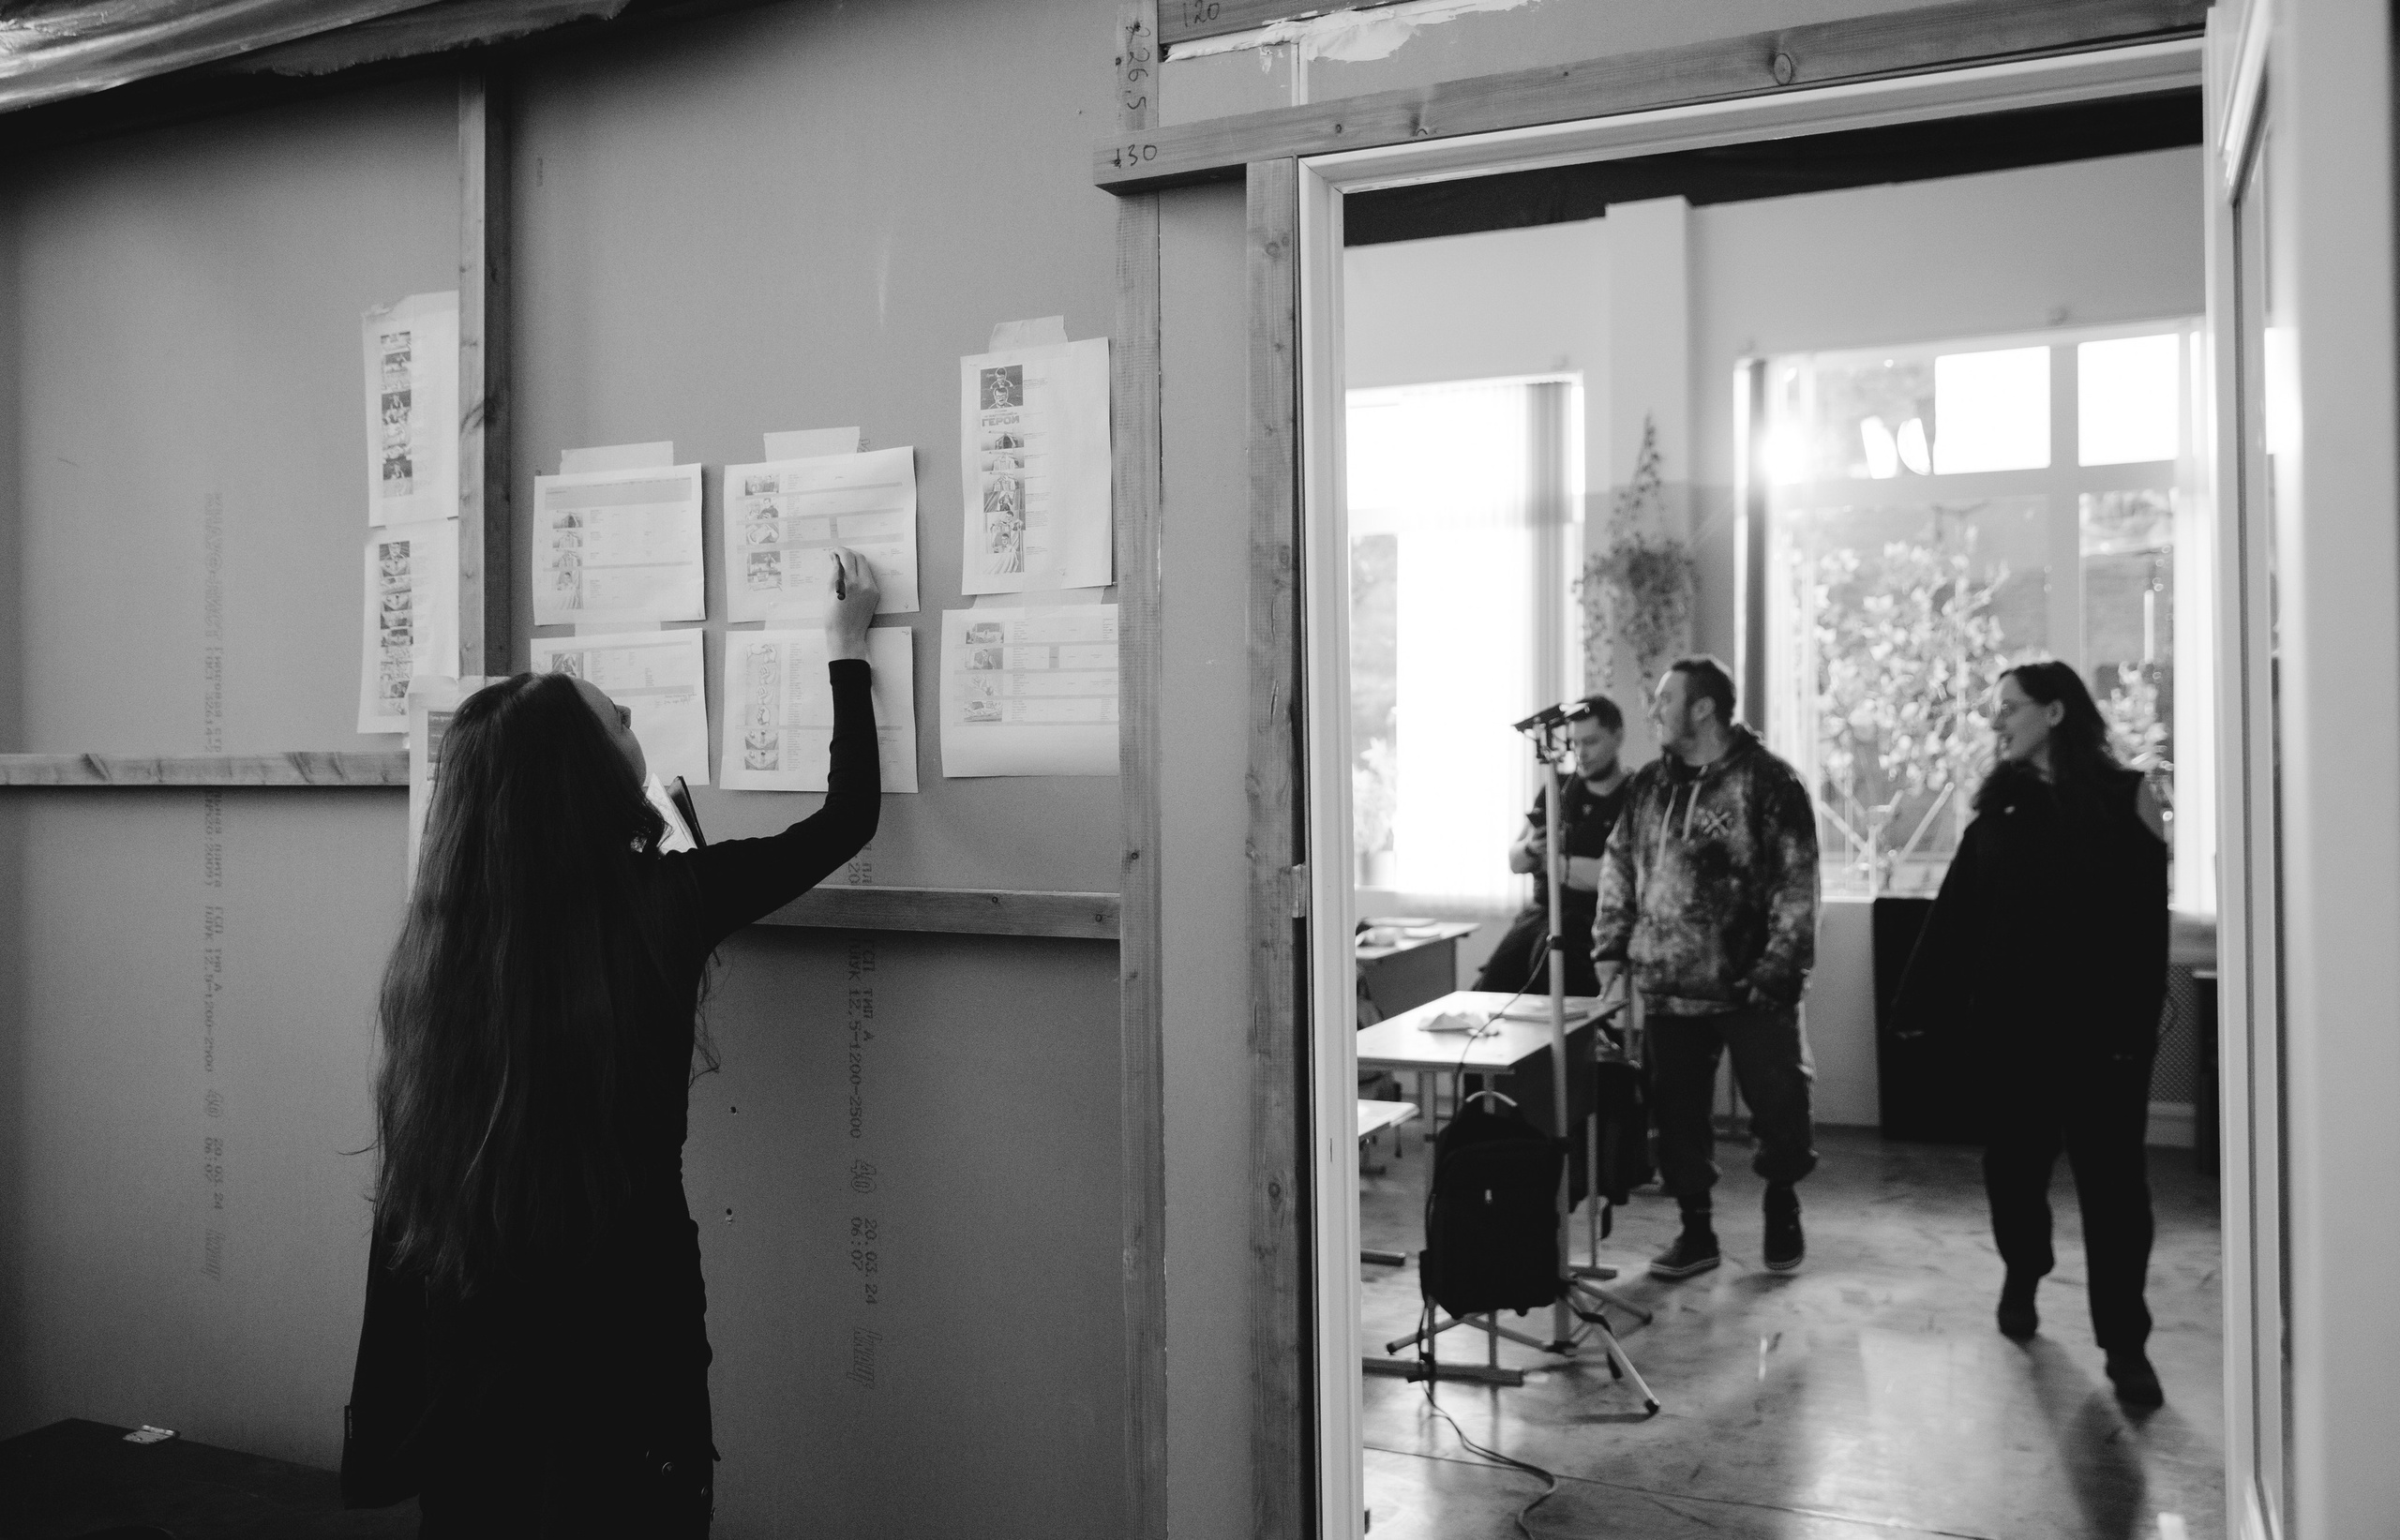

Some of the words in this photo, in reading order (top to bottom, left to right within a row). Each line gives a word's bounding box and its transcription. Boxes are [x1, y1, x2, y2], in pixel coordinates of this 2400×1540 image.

[1182, 0, 1221, 27] 120
[1113, 144, 1157, 169] 130
[848, 937, 862, 981] ПЛУК
[862, 938, 876, 972] ГСП
[862, 988, 874, 1019] тип
[850, 1159, 877, 1194] 40
[850, 1216, 863, 1271] 06:07
[864, 1218, 878, 1306] 20.03.24
